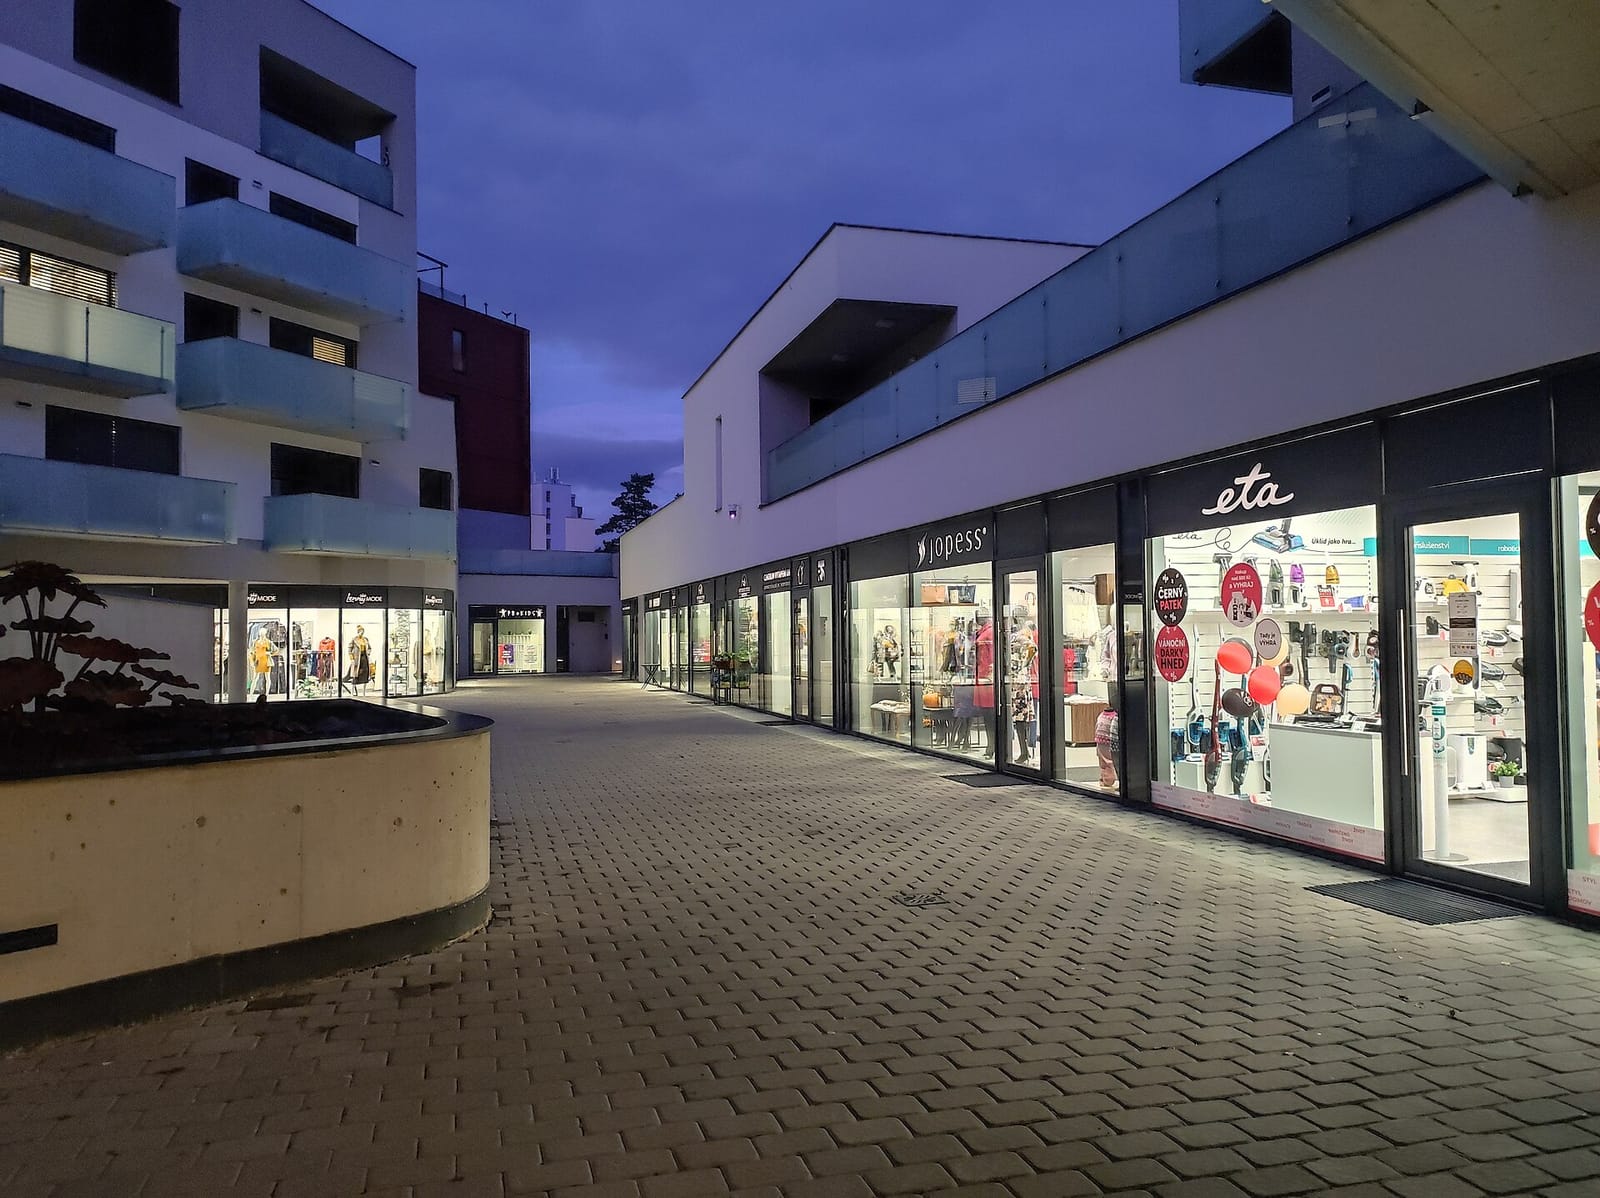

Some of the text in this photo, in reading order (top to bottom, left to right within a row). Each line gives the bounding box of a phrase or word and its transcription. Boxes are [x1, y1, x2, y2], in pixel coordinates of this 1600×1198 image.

[1201, 462, 1294, 516] eta
[928, 528, 982, 564] jopess
[1327, 537, 1341, 546] jako
[1158, 584, 1184, 599] ČERNÝ
[1160, 599, 1183, 610] PÁTEK
[1158, 637, 1186, 648] VÁNOČNÍ
[1160, 647, 1184, 658] DÁRKY
[1161, 658, 1185, 669] HNED
